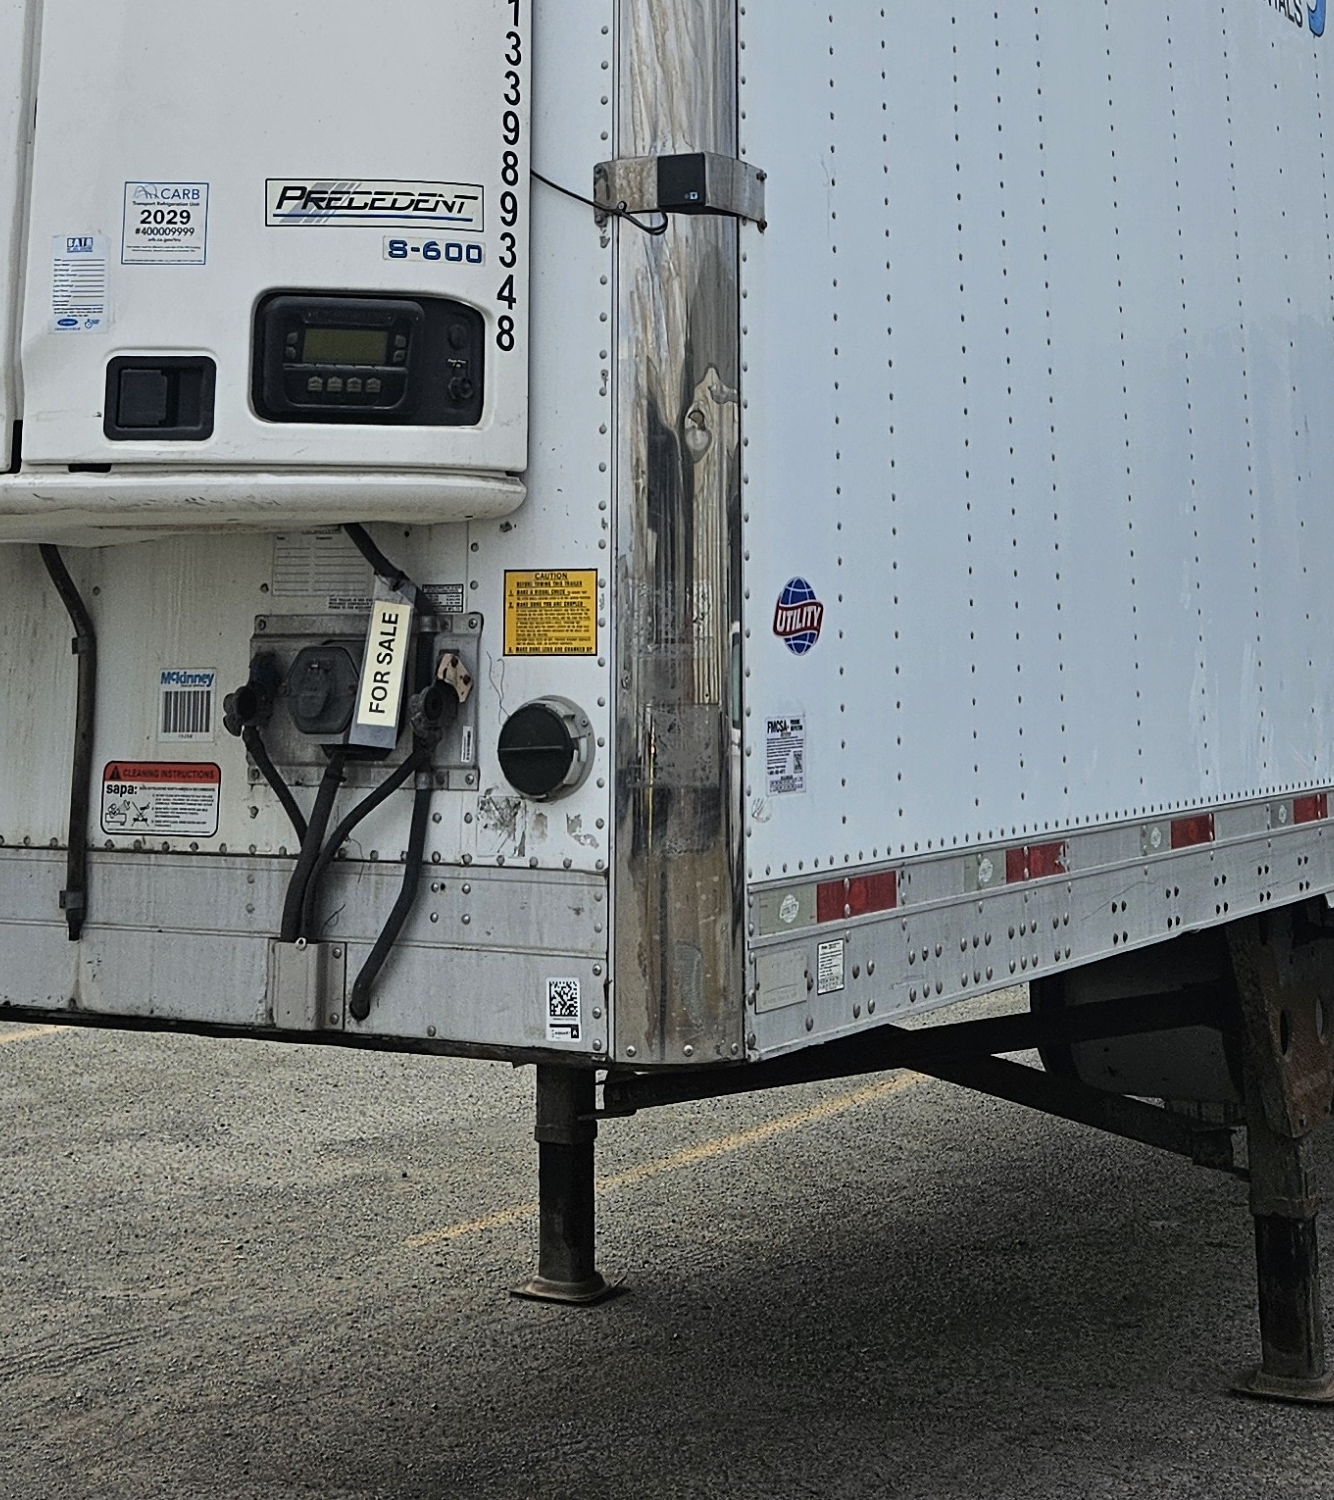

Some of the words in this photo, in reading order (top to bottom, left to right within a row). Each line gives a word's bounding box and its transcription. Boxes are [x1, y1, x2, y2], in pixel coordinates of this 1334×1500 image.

[160, 187, 201, 200] CARB
[140, 209, 191, 225] 2029
[388, 239, 482, 264] S-600
[535, 572, 568, 580] CAUTION
[776, 605, 821, 632] UTILITY
[377, 612, 399, 665] SALE
[369, 671, 391, 713] FOR
[123, 768, 159, 778] CLEANING
[161, 769, 215, 779] INSTRUCTIONS
